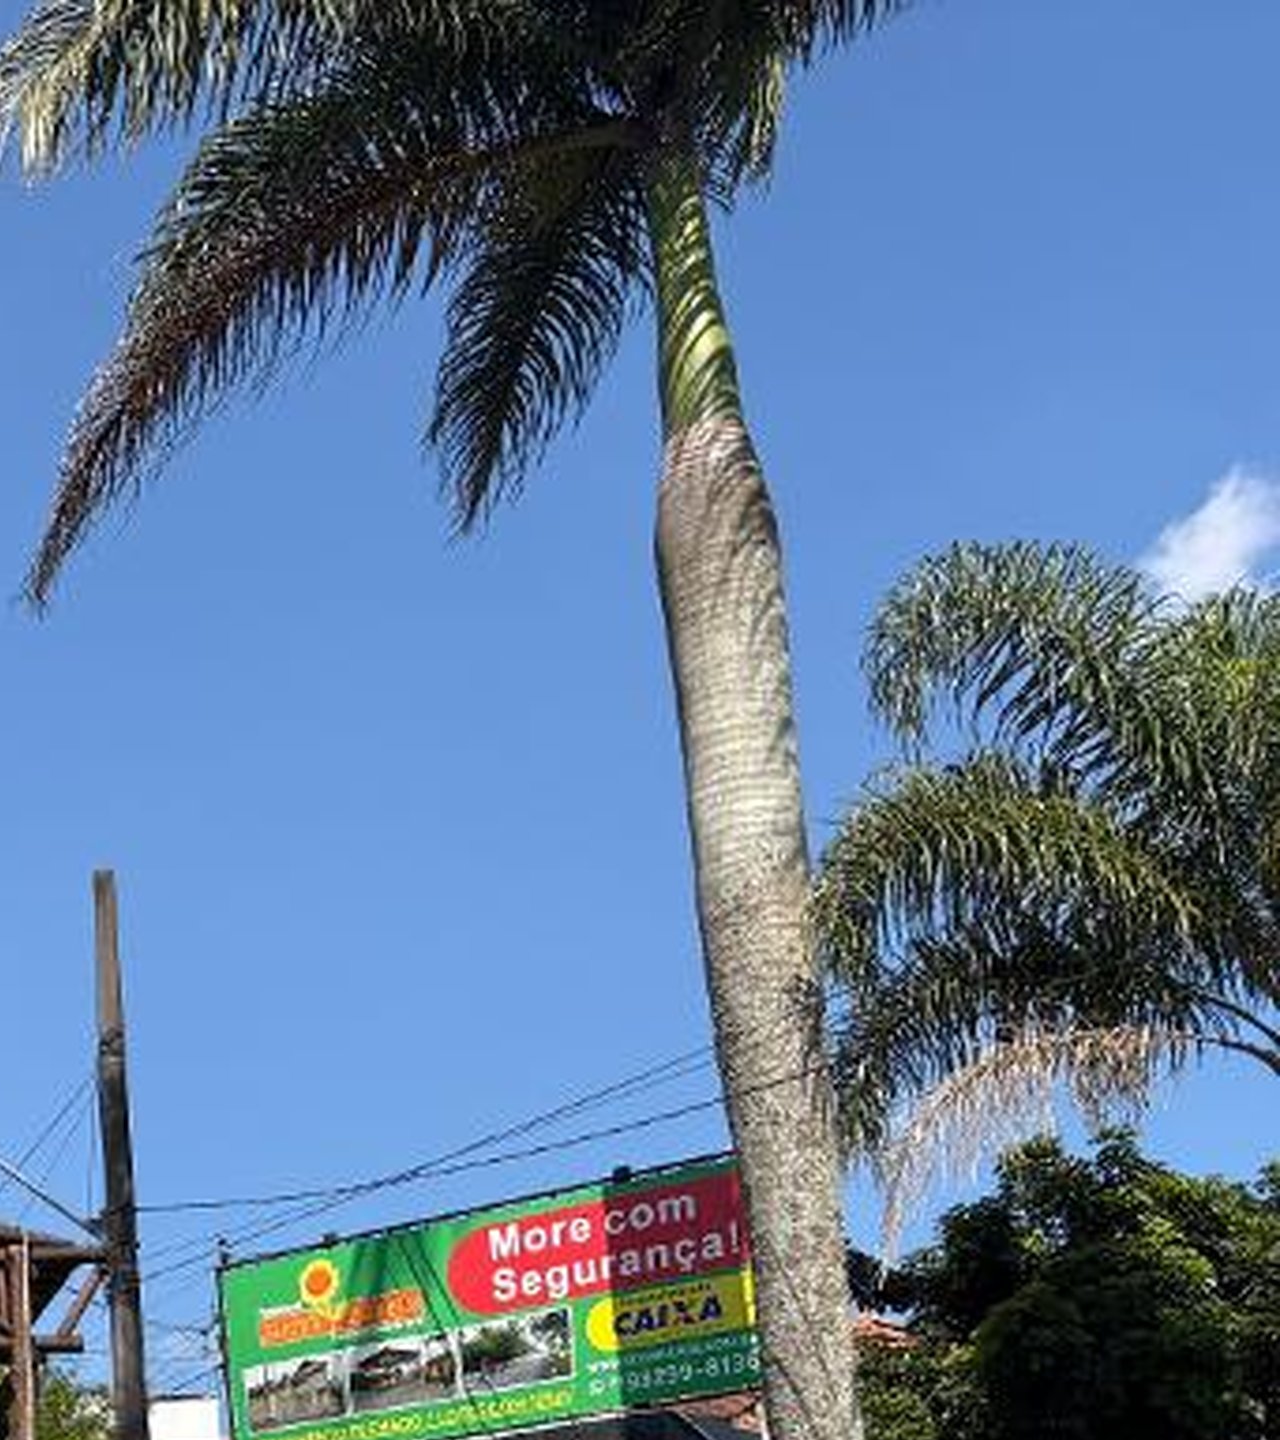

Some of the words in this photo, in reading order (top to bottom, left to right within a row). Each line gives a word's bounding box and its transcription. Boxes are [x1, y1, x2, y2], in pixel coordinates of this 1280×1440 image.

[488, 1216, 591, 1260] More
[603, 1194, 697, 1234] com
[492, 1221, 742, 1299] Segurança!
[614, 1295, 723, 1336] CAIXA
